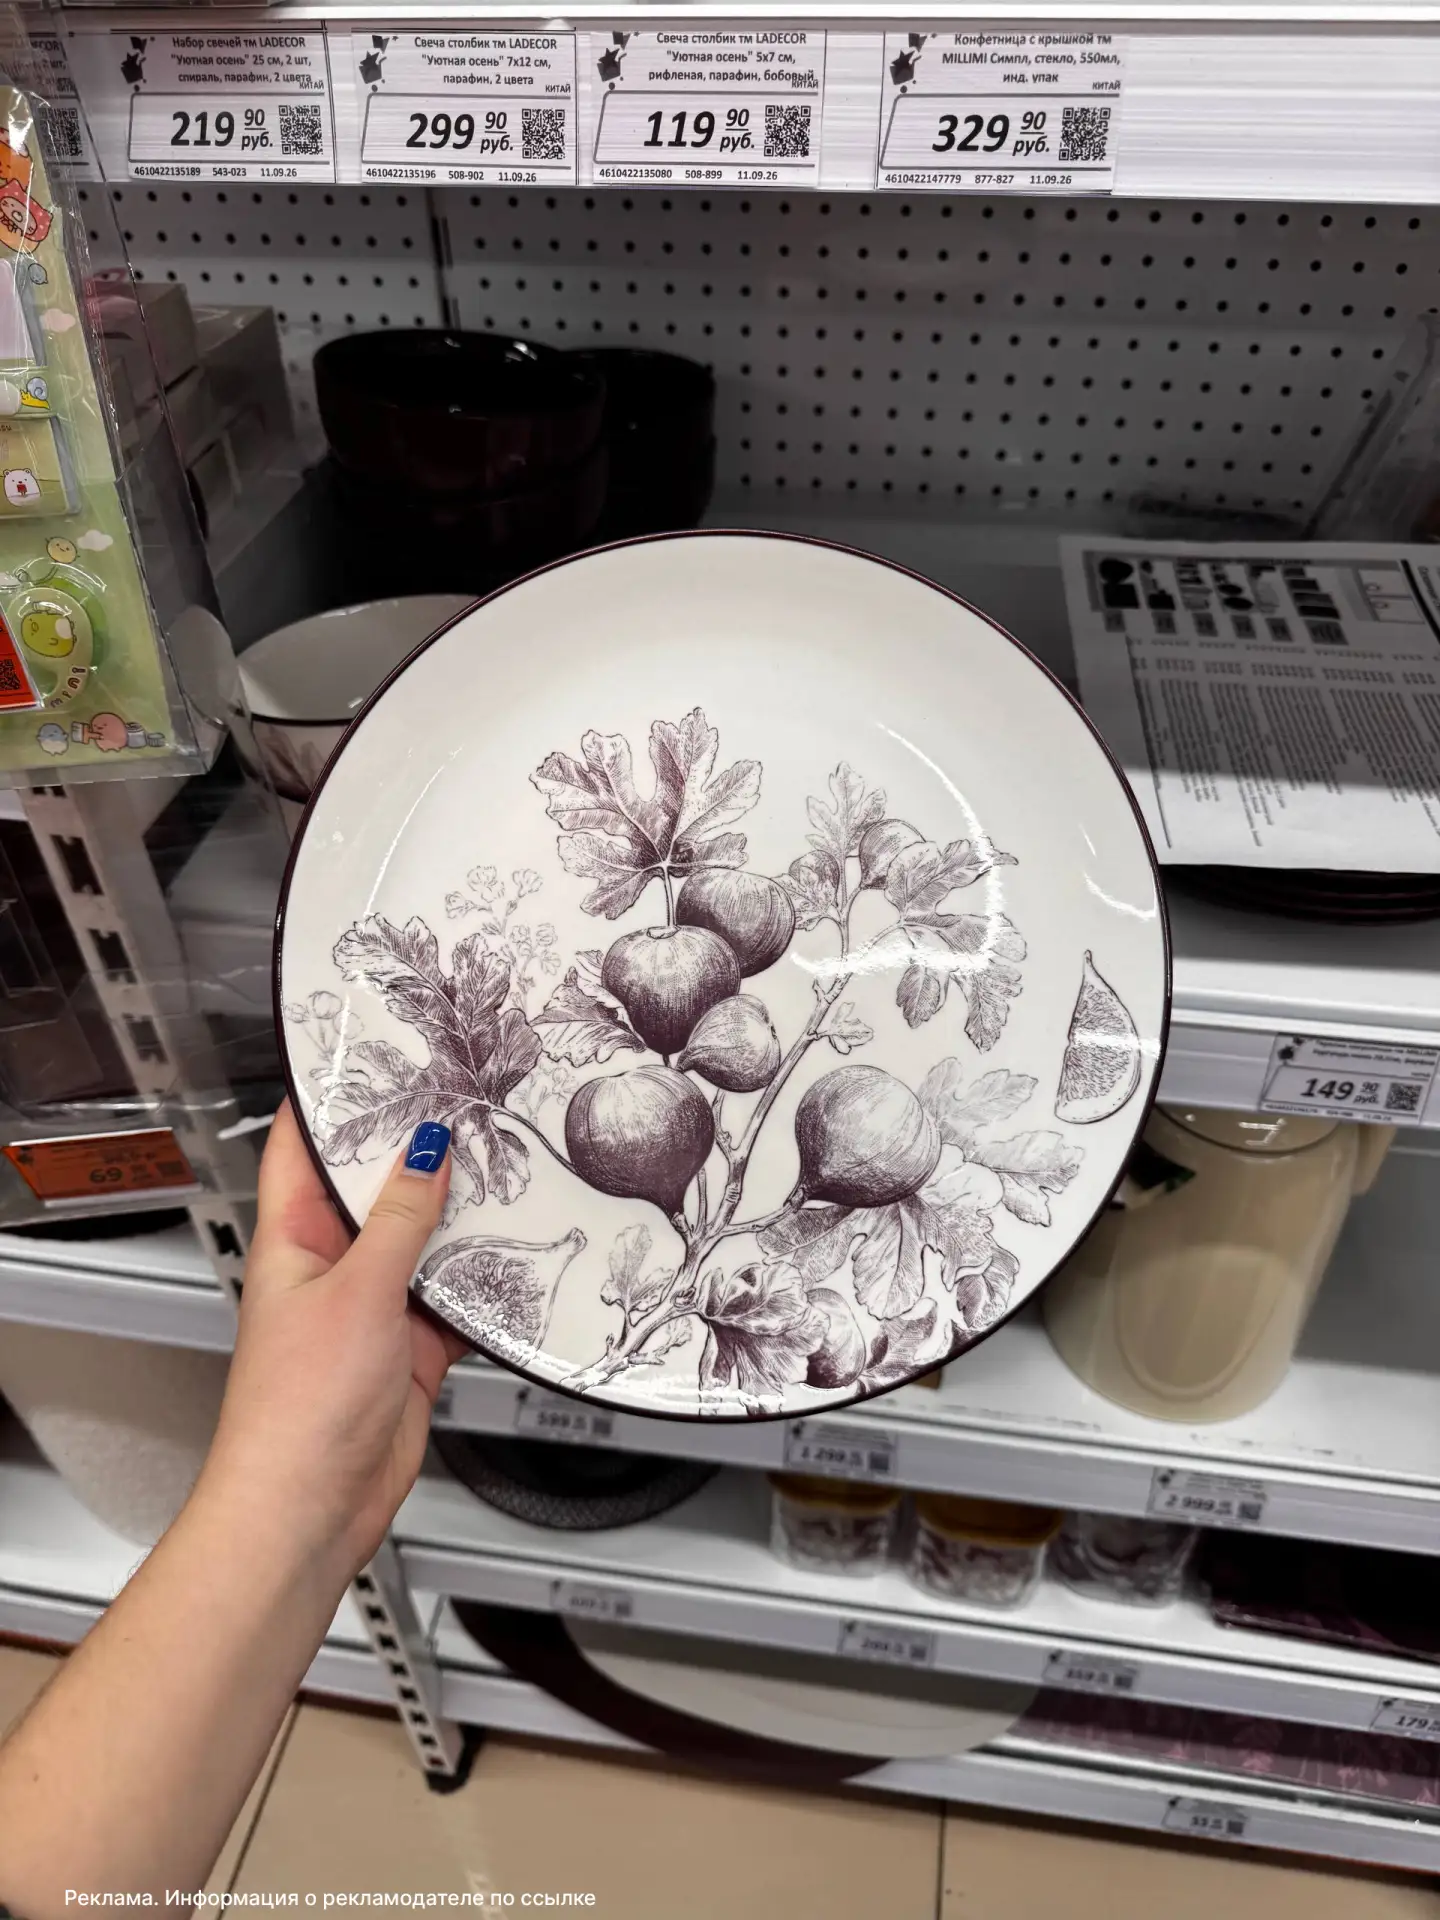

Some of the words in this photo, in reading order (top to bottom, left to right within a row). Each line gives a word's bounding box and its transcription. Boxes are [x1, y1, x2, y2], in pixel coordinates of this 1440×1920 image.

[172, 36, 204, 50] Набор
[206, 36, 241, 47] свечей
[243, 38, 257, 47] тм
[259, 37, 306, 48] LADECOR
[414, 36, 445, 48] Свеча
[447, 36, 490, 49] столбик
[492, 39, 507, 49] тм
[509, 38, 557, 49] LADECOR
[656, 33, 689, 44] Свеча
[691, 32, 736, 44] столбик
[738, 35, 752, 44] тм
[755, 33, 807, 44] LADECOR
[954, 33, 1026, 46] Конфетница
[1038, 33, 1094, 47] крышкой
[1096, 35, 1112, 45] тм
[171, 54, 214, 66] "Уютная
[216, 55, 250, 66] осень"
[252, 55, 265, 66] 25
[266, 58, 284, 67] см,
[286, 56, 293, 65] 2
[294, 57, 312, 67] шт,
[421, 55, 466, 67] "Уютная
[468, 55, 505, 67] осень"
[533, 58, 551, 69] см,
[666, 51, 713, 63] "Уютная
[715, 51, 752, 62] осень"
[778, 53, 796, 64] см,
[942, 53, 987, 64] MILLIMI
[990, 53, 1032, 65] Симпл,
[1034, 54, 1077, 65] стекло,
[1079, 53, 1120, 65] 550мл,
[178, 73, 222, 84] спираль,
[224, 73, 272, 84] парафин,
[274, 73, 281, 83] 2
[495, 75, 502, 84] 2
[504, 76, 534, 86] цвета
[649, 70, 706, 82] рифленая,
[709, 70, 761, 82] парафин,
[1003, 73, 1028, 84] инд.
[545, 83, 571, 93] КИТАЙ
[1092, 80, 1121, 90] КИТАЙ
[170, 111, 235, 147] 219
[244, 108, 265, 126] 90
[406, 112, 475, 149] 299
[485, 111, 507, 129] 90
[644, 111, 715, 148] 119
[725, 108, 750, 127] 90
[932, 114, 1010, 152] 329
[1021, 111, 1046, 130] 90
[241, 132, 273, 150] руб.
[480, 135, 514, 154] руб.
[720, 132, 755, 152] руб.
[1012, 135, 1050, 156] руб.
[134, 166, 201, 176] 4610422135189
[212, 168, 247, 177] 543-023
[260, 168, 297, 178] 11.09.26
[366, 167, 436, 179] 4610422135196
[448, 170, 484, 181] 508-902
[498, 172, 537, 182] 11.09.26
[599, 168, 673, 178] 4610422135080
[684, 169, 723, 180] 508-899
[737, 170, 778, 180] 11.09.26
[885, 174, 961, 184] 4610422147779
[974, 174, 1014, 184] 877-827
[1029, 175, 1072, 185] 11.09.26
[1300, 1078, 1354, 1100] 149
[89, 1167, 123, 1184] 69
[1395, 1715, 1428, 1729] 179
